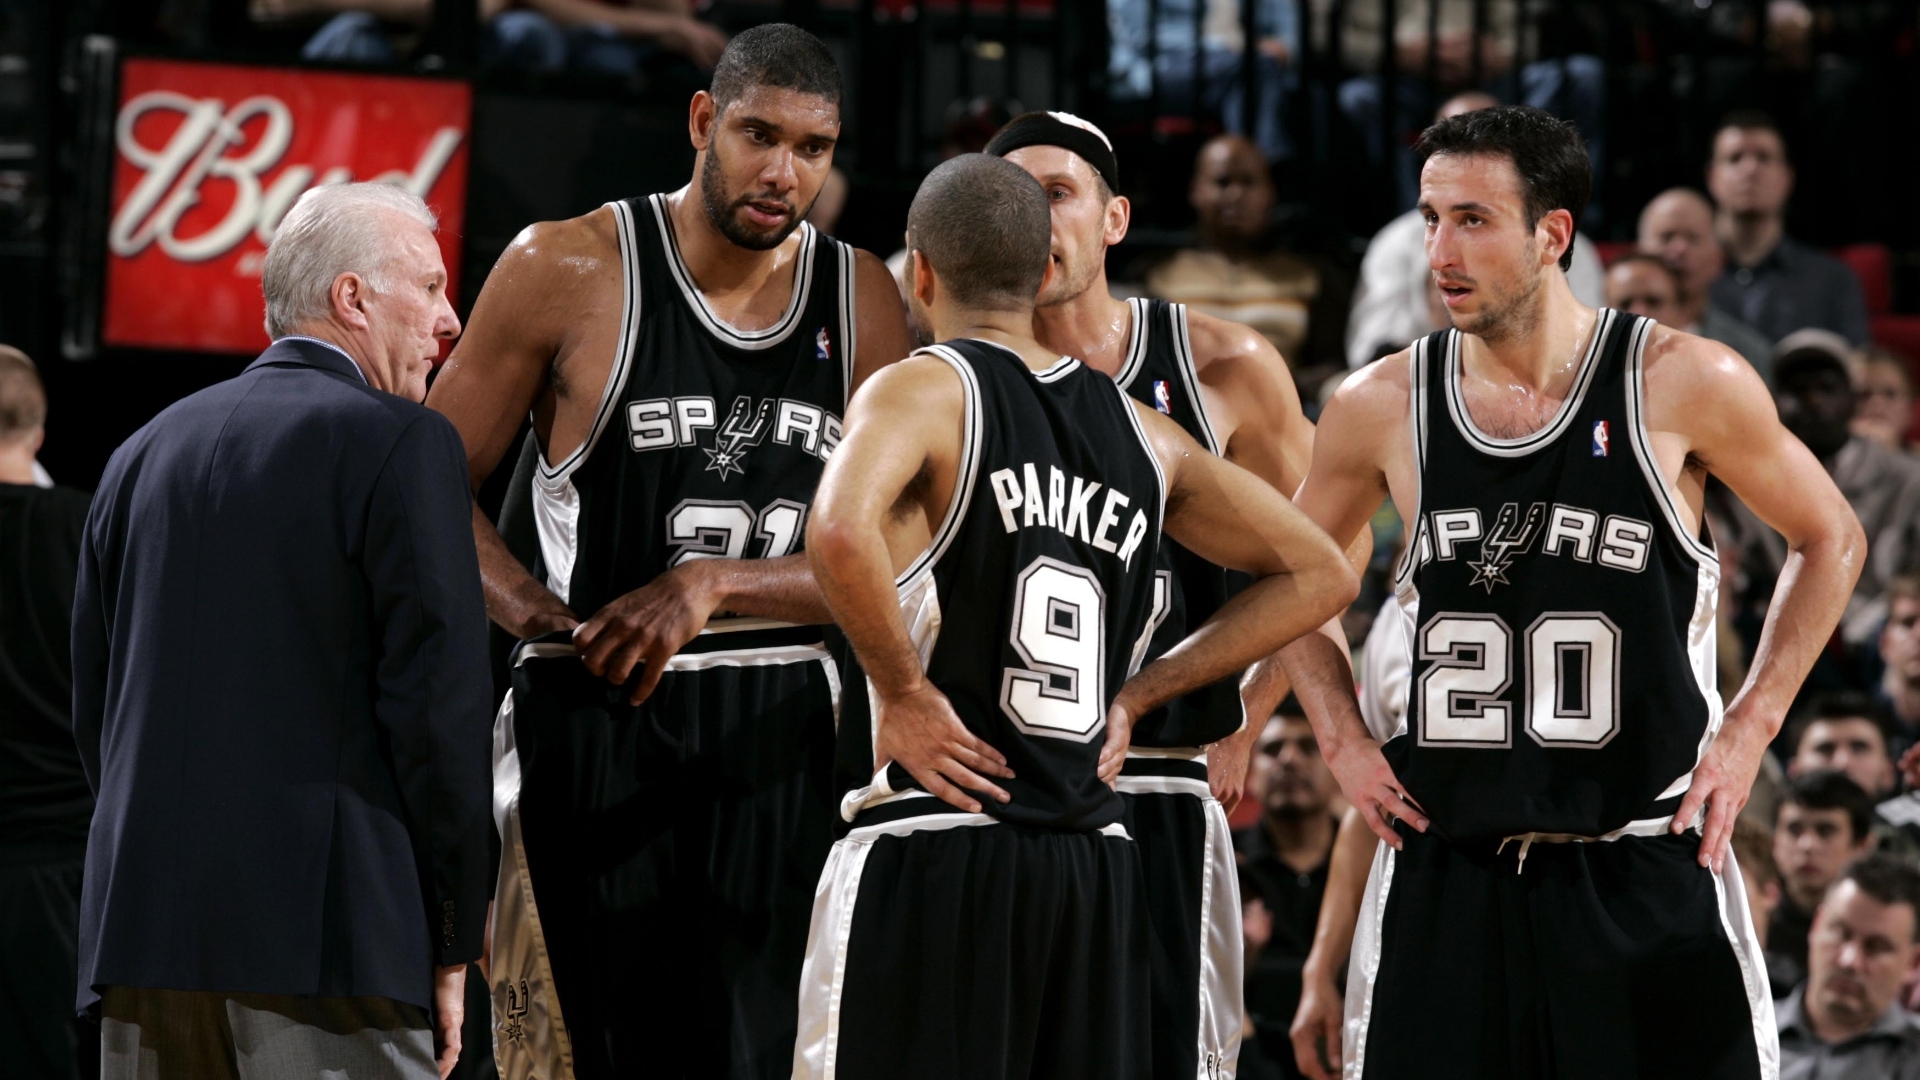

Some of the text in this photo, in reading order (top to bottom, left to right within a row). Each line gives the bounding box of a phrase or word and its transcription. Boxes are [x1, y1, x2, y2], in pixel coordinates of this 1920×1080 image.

[626, 396, 843, 482] SPURS
[666, 498, 807, 569] 21
[990, 462, 1147, 573] PARKER
[1421, 502, 1653, 594] PURS
[999, 555, 1107, 743] 9
[1418, 611, 1622, 749] 20
